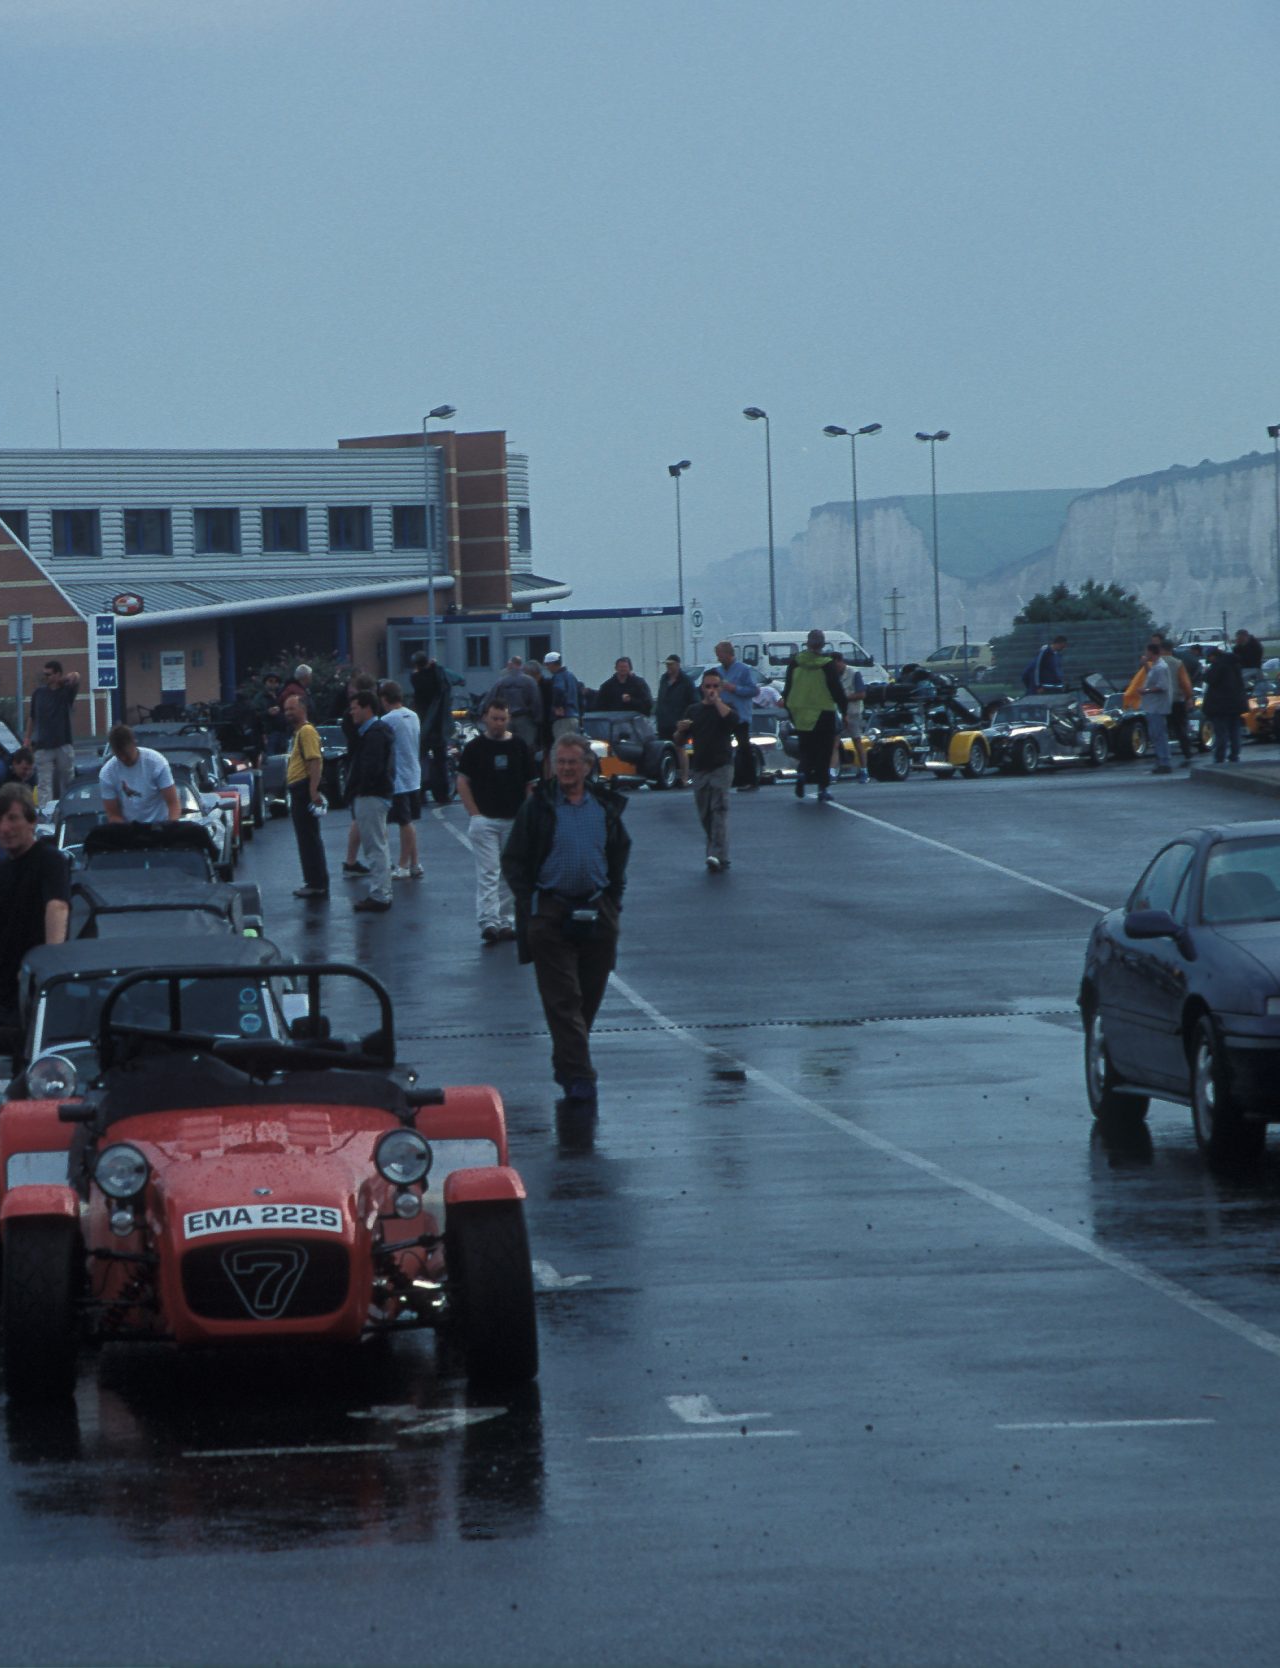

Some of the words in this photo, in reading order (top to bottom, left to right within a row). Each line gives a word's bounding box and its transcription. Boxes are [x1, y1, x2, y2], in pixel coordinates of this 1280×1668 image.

[188, 1208, 252, 1233] EMA
[261, 1206, 338, 1227] 222S
[233, 1250, 299, 1309] 7
